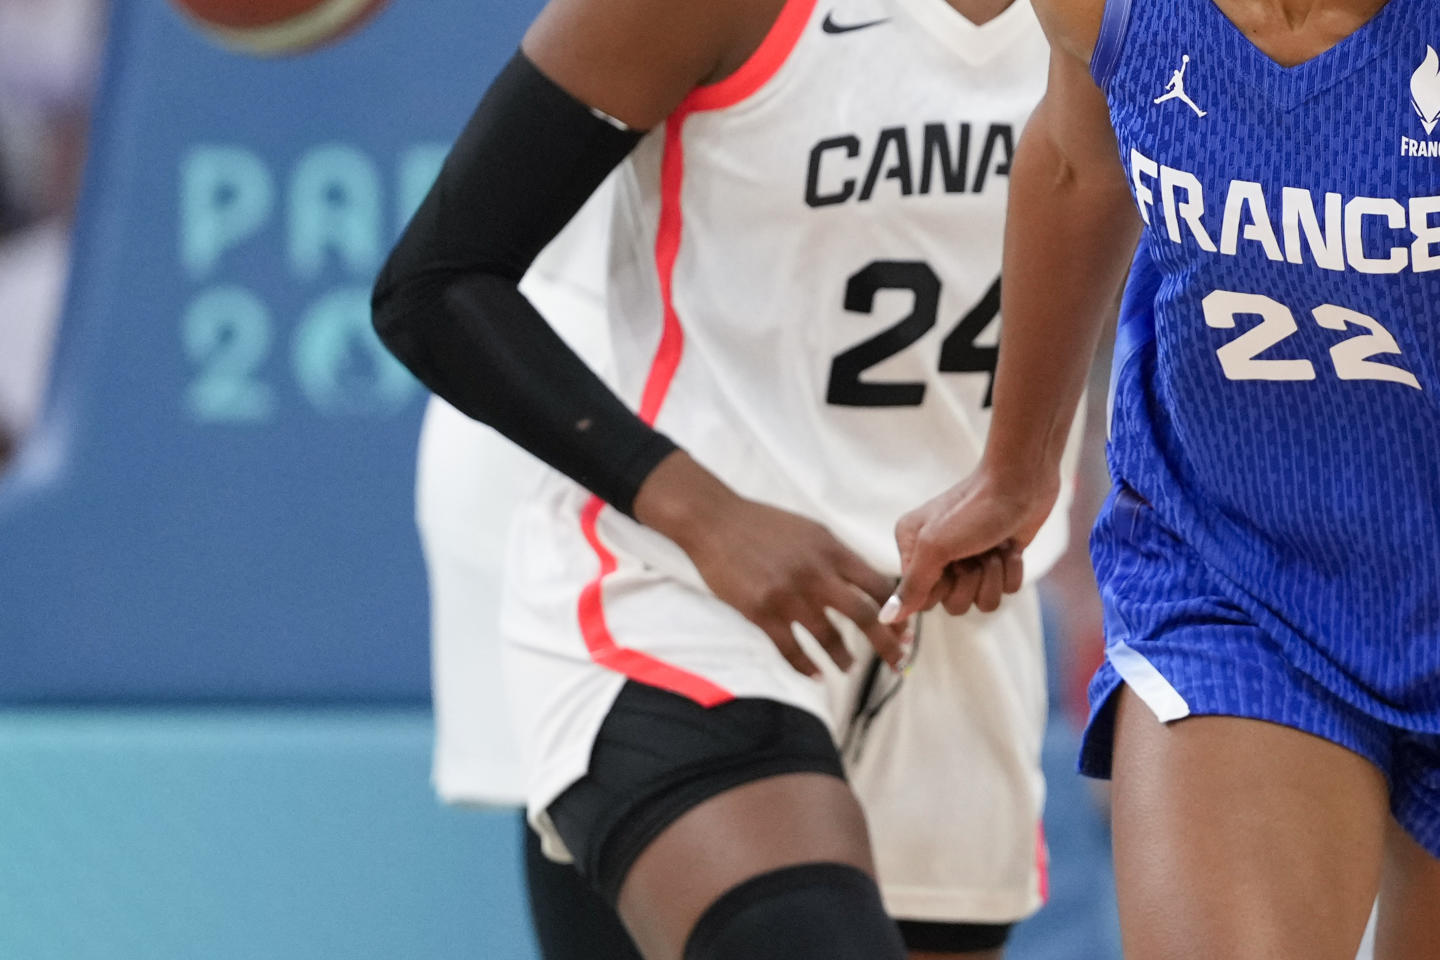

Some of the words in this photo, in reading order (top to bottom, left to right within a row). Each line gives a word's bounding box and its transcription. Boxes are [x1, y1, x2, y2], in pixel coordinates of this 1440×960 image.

[804, 122, 1013, 208] CANA
[826, 260, 1003, 409] 24
[1202, 290, 1423, 390] 22
